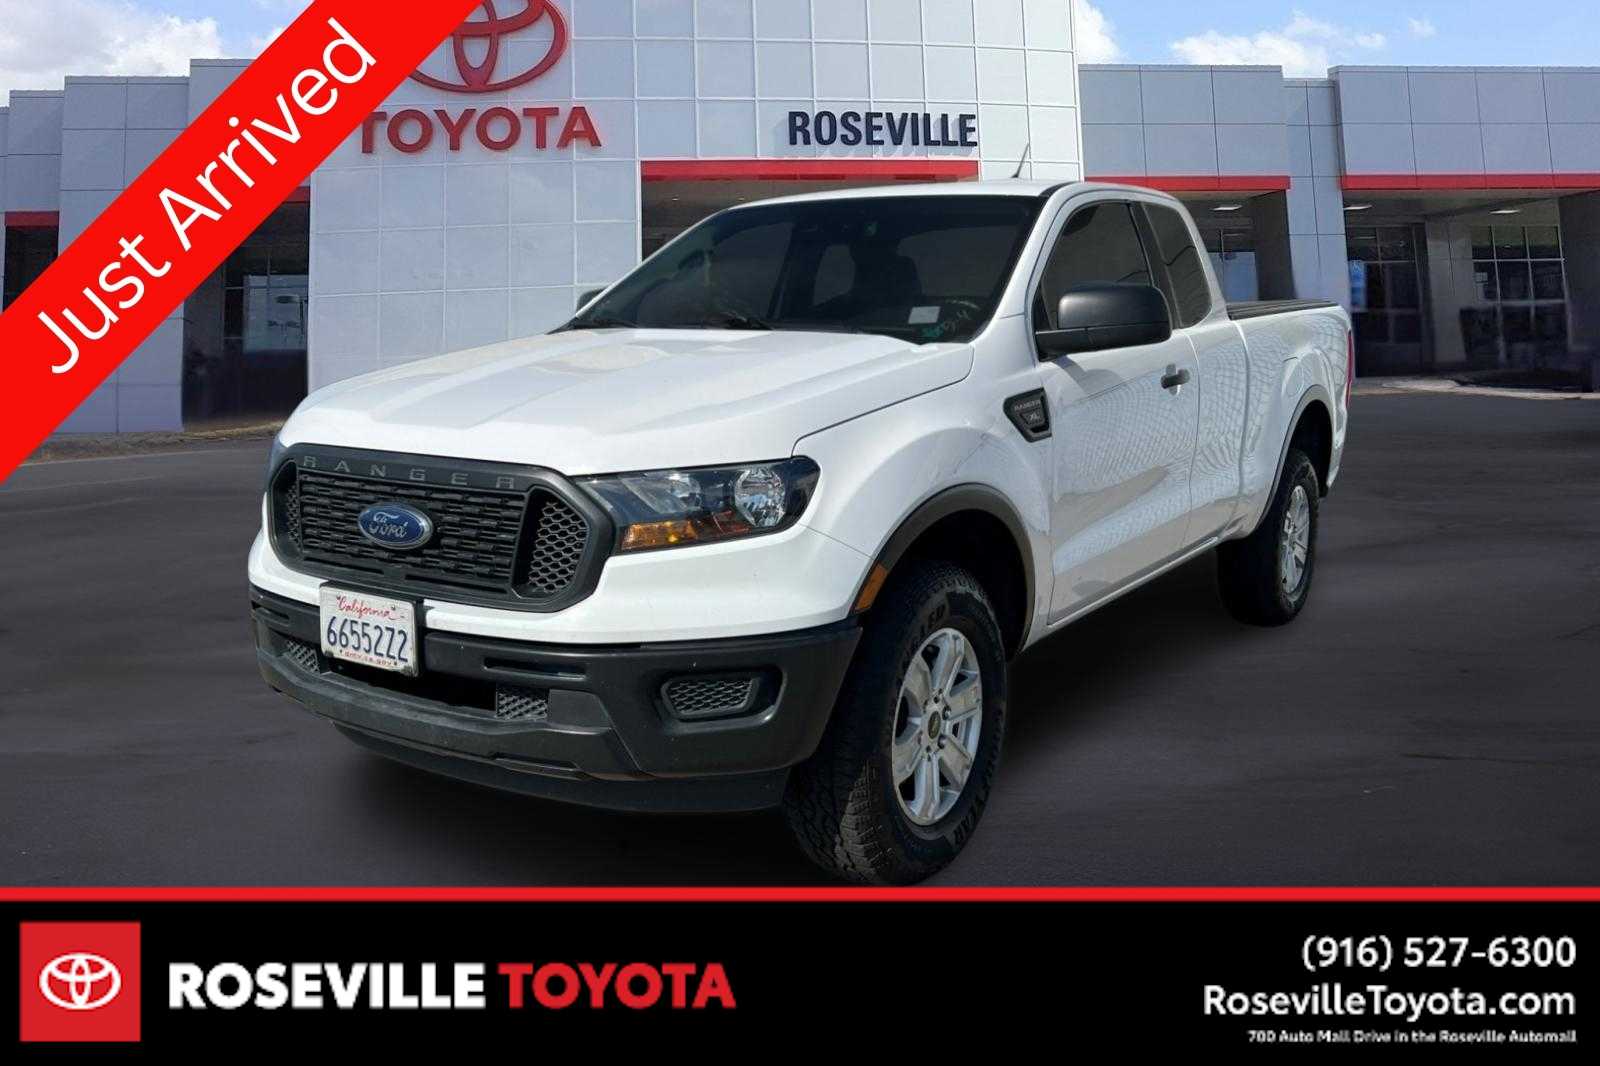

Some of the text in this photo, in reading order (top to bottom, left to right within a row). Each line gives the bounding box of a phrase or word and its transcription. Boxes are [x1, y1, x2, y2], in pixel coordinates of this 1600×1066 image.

[361, 106, 602, 154] TOYOTA
[788, 110, 978, 147] ROSEVILLE
[303, 456, 514, 489] RANGER
[369, 511, 409, 539] Ford
[336, 594, 391, 618] California
